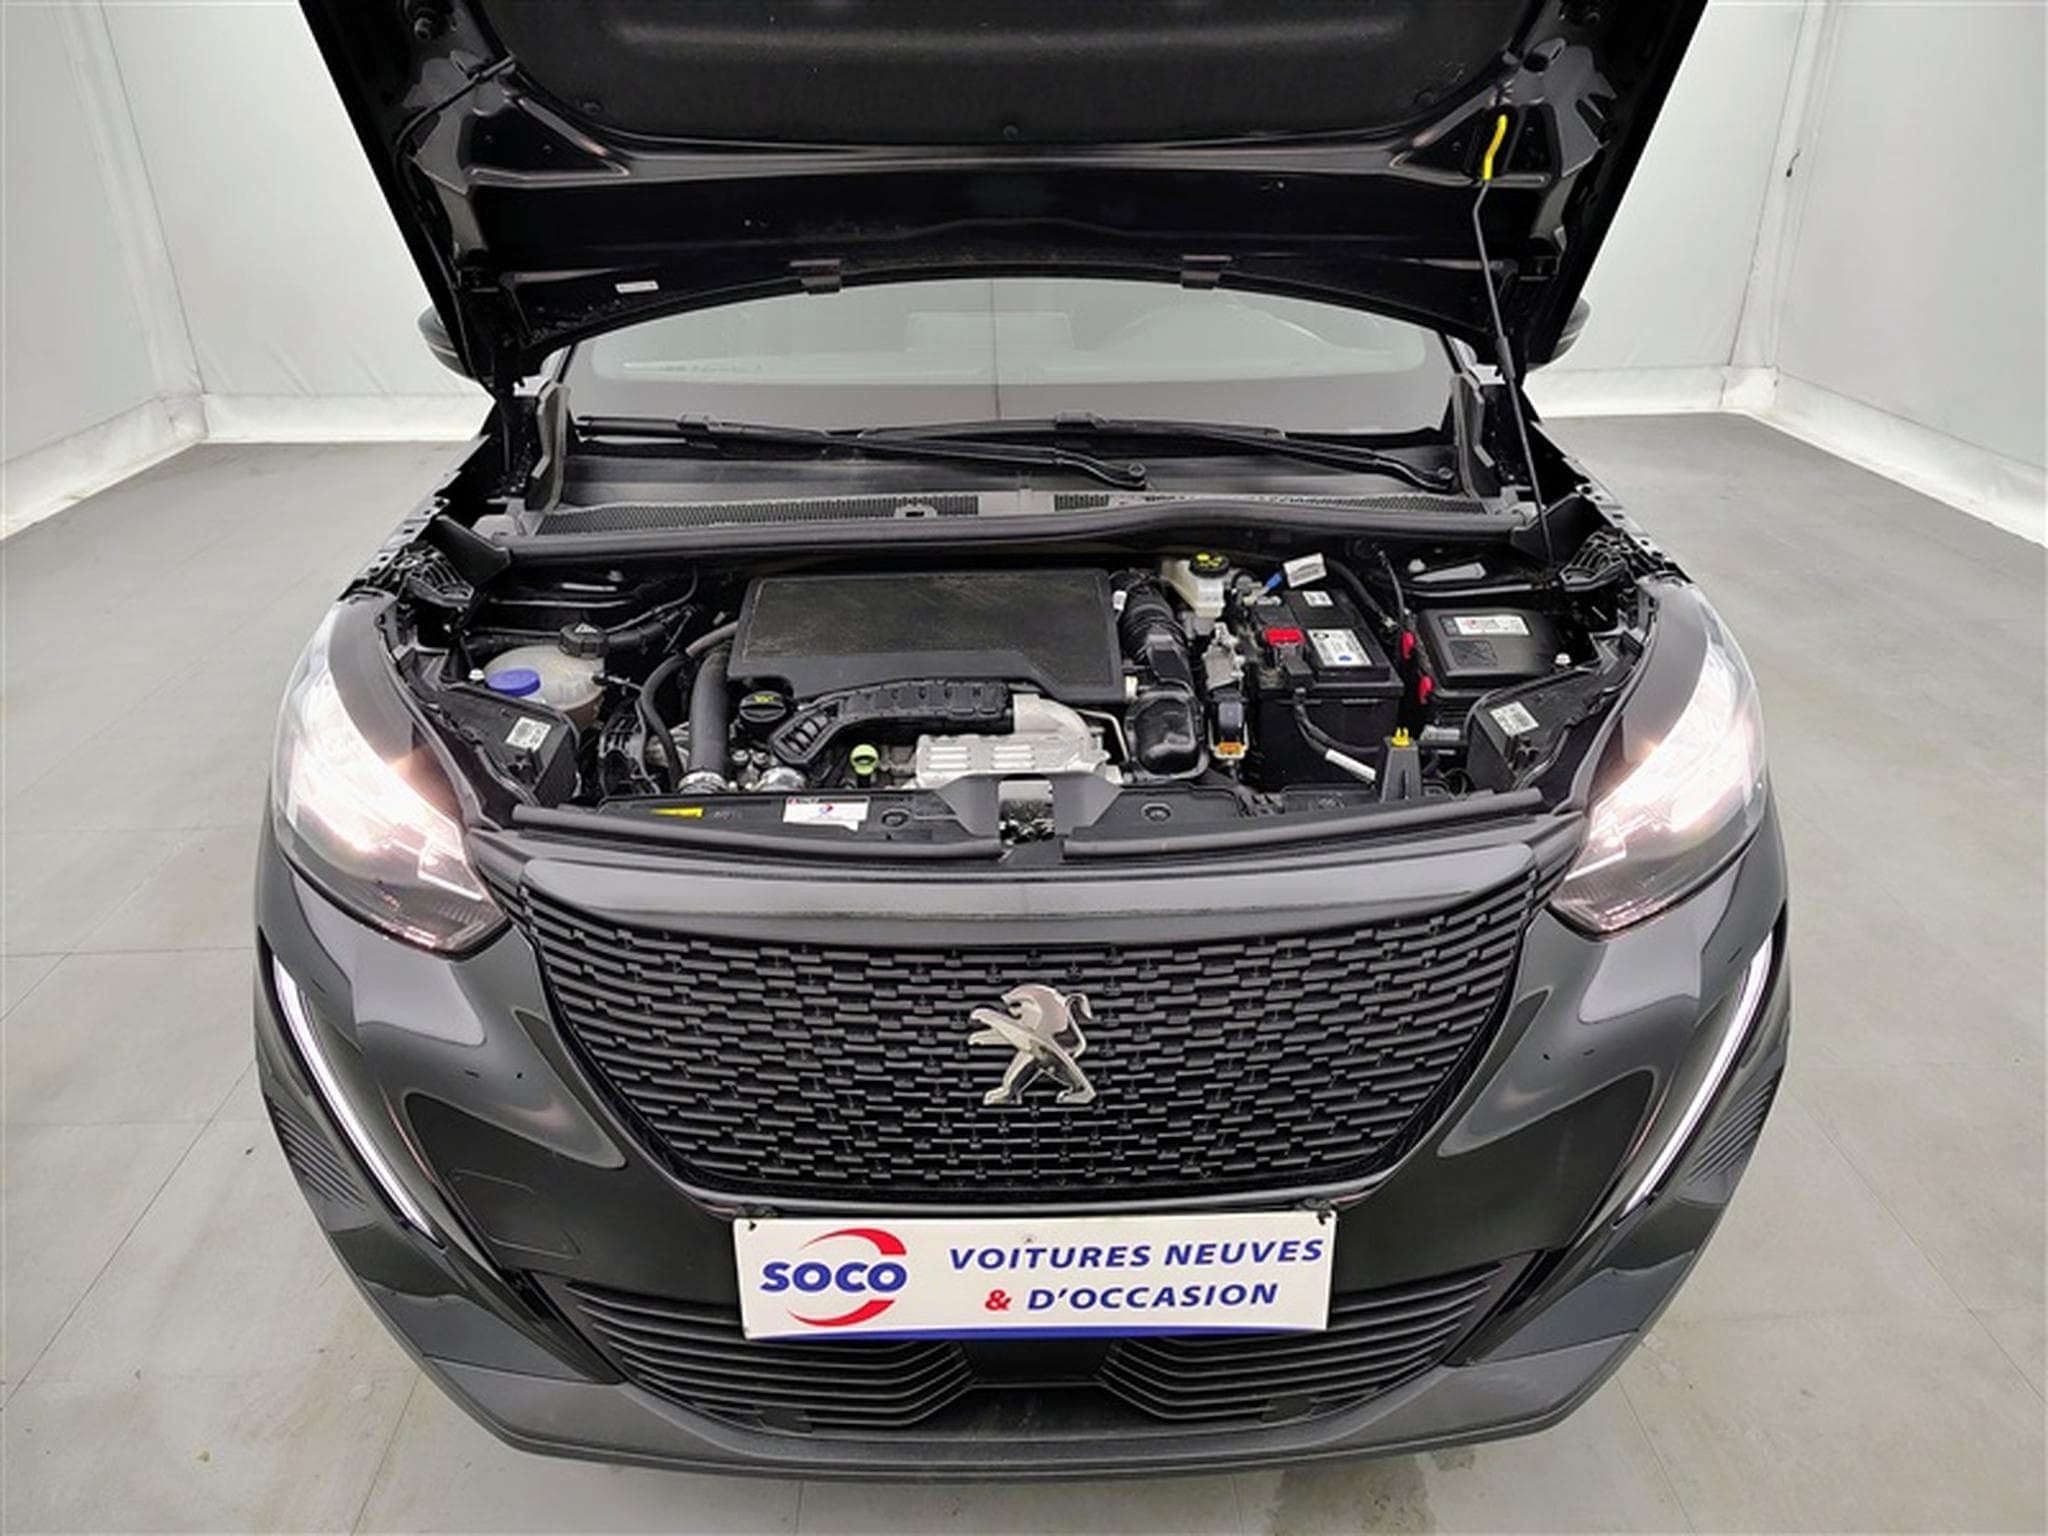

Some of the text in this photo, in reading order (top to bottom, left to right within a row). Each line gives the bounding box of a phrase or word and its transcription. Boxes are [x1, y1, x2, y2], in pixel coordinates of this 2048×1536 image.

[950, 1239, 1324, 1271] VOITURES NEUVES
[760, 1261, 908, 1294] SOCO
[984, 1283, 1279, 1312] & D'OCCASION
